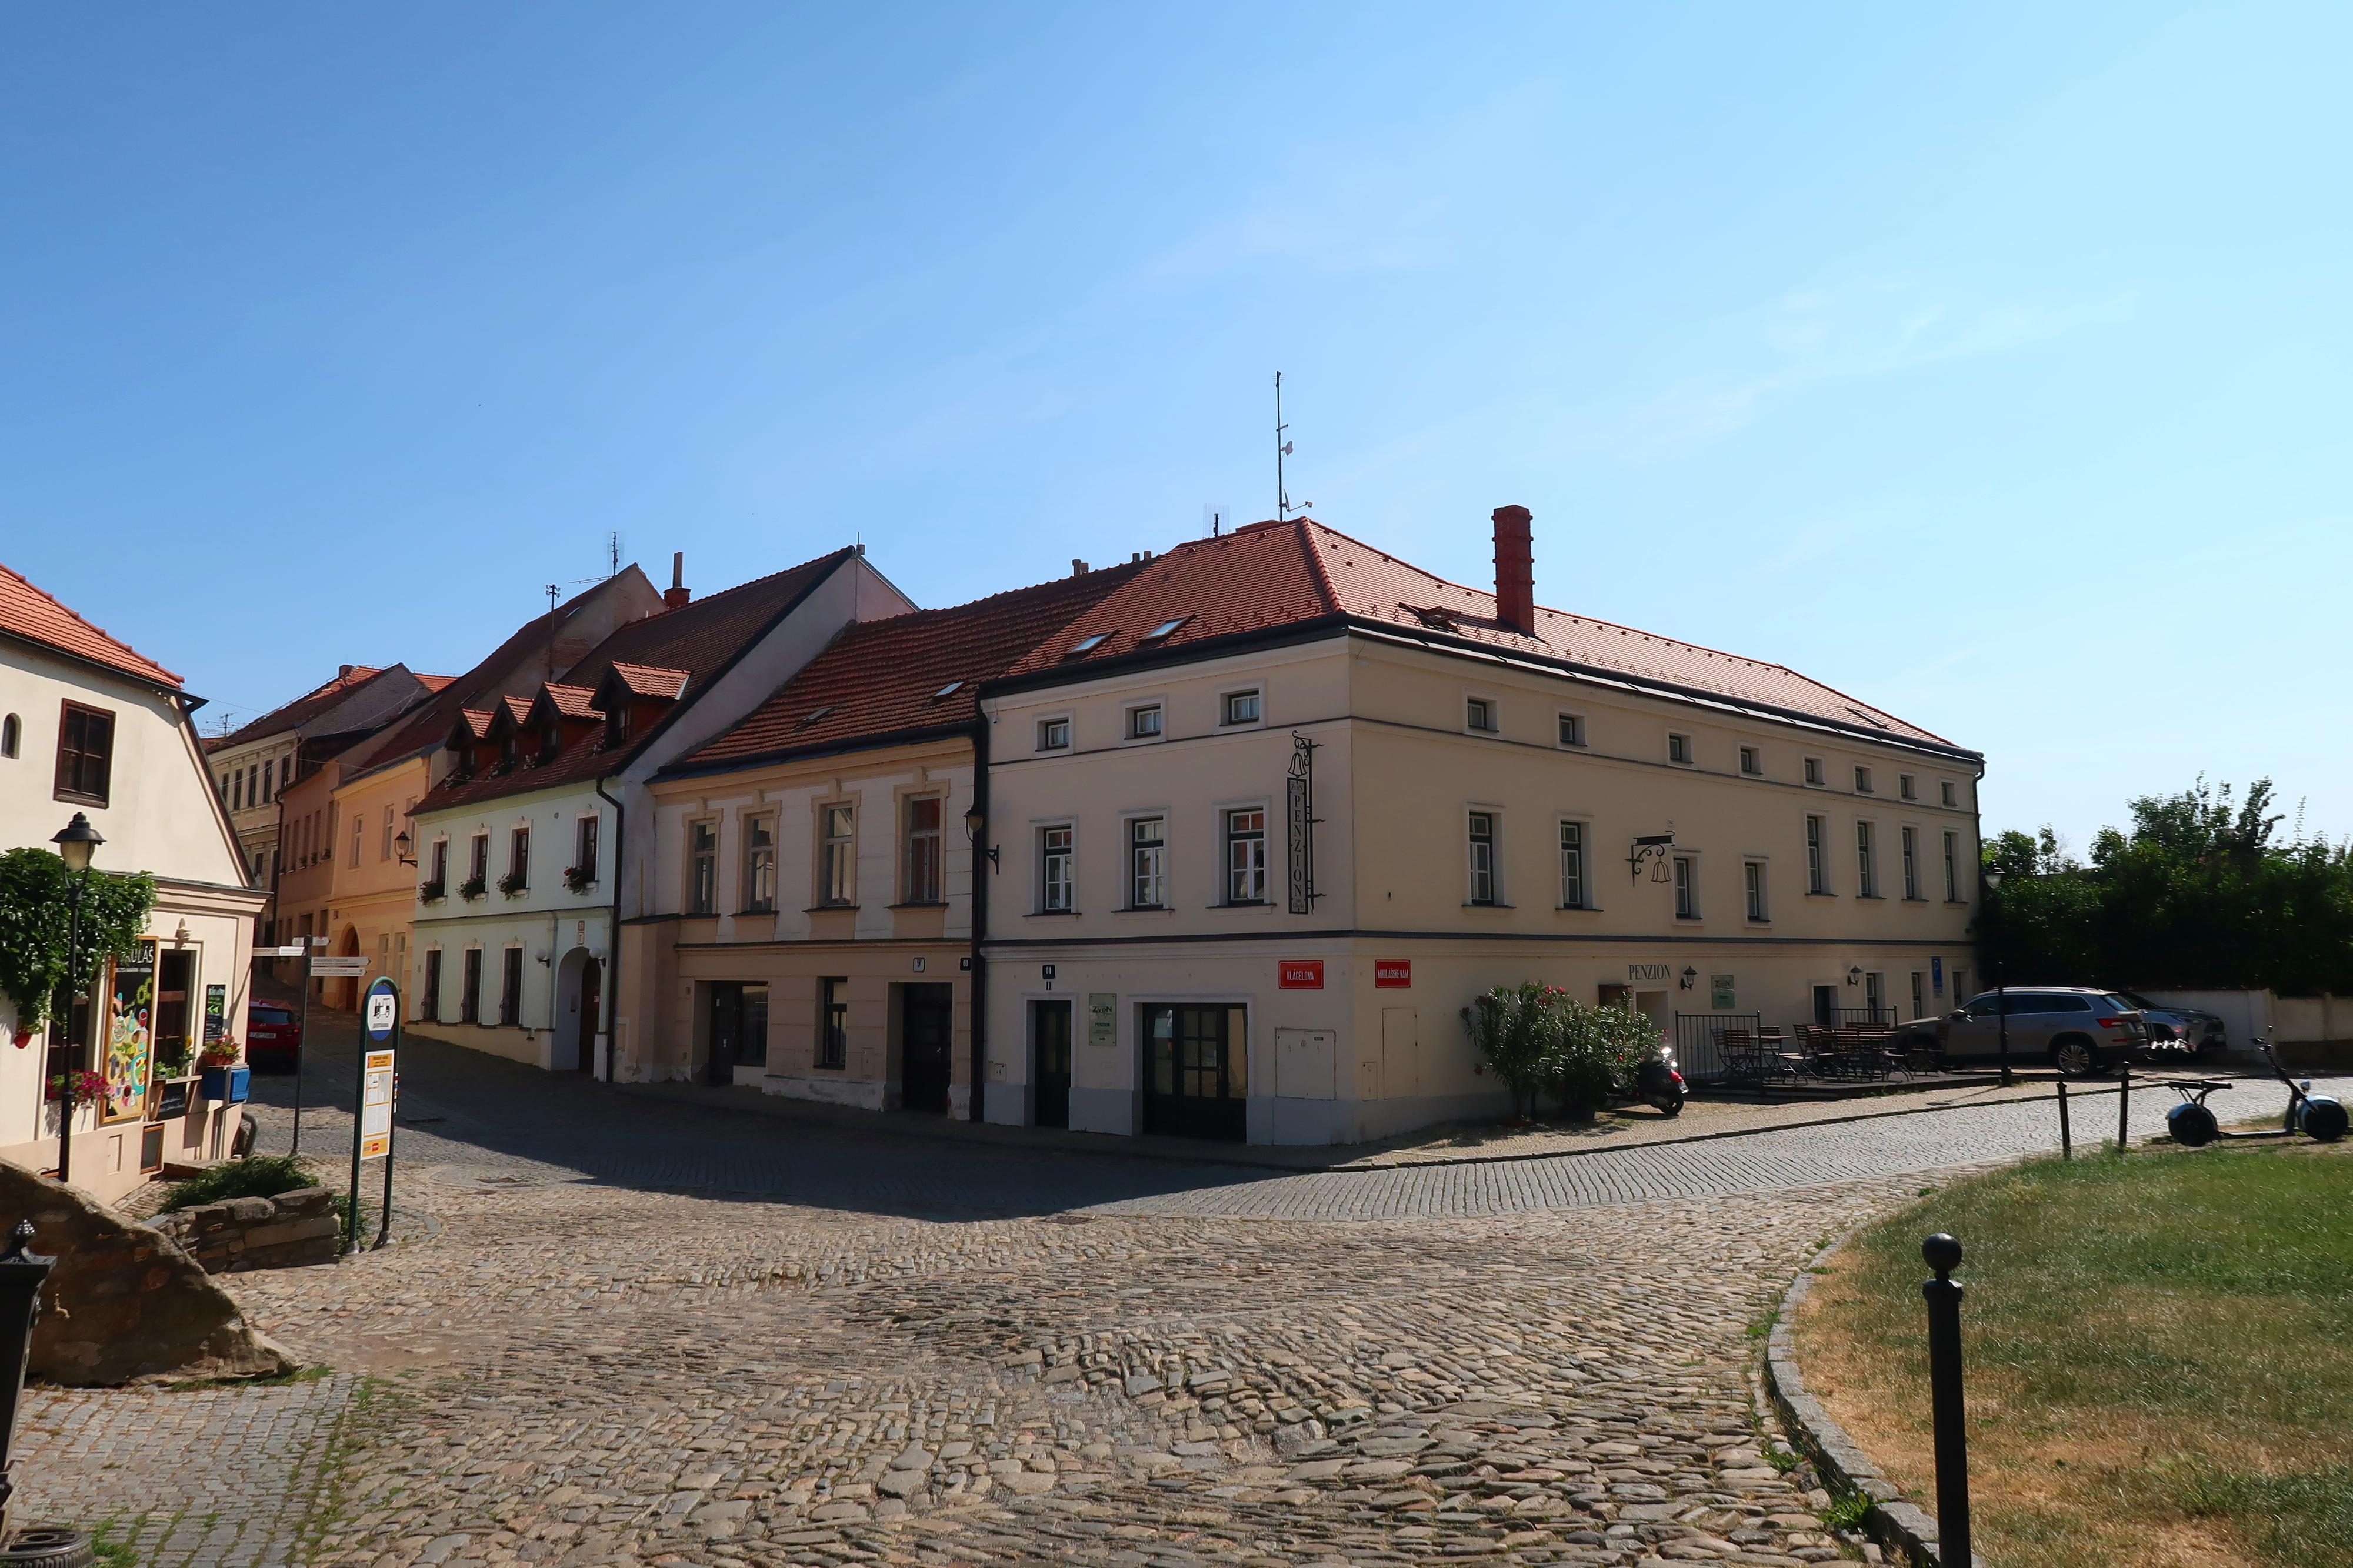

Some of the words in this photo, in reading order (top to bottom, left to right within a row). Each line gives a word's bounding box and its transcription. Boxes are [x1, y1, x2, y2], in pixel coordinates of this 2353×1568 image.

[1294, 795, 1302, 897] PENZION
[1287, 969, 1314, 981] KLÁCELOVA
[1628, 963, 1671, 980] PENZION
